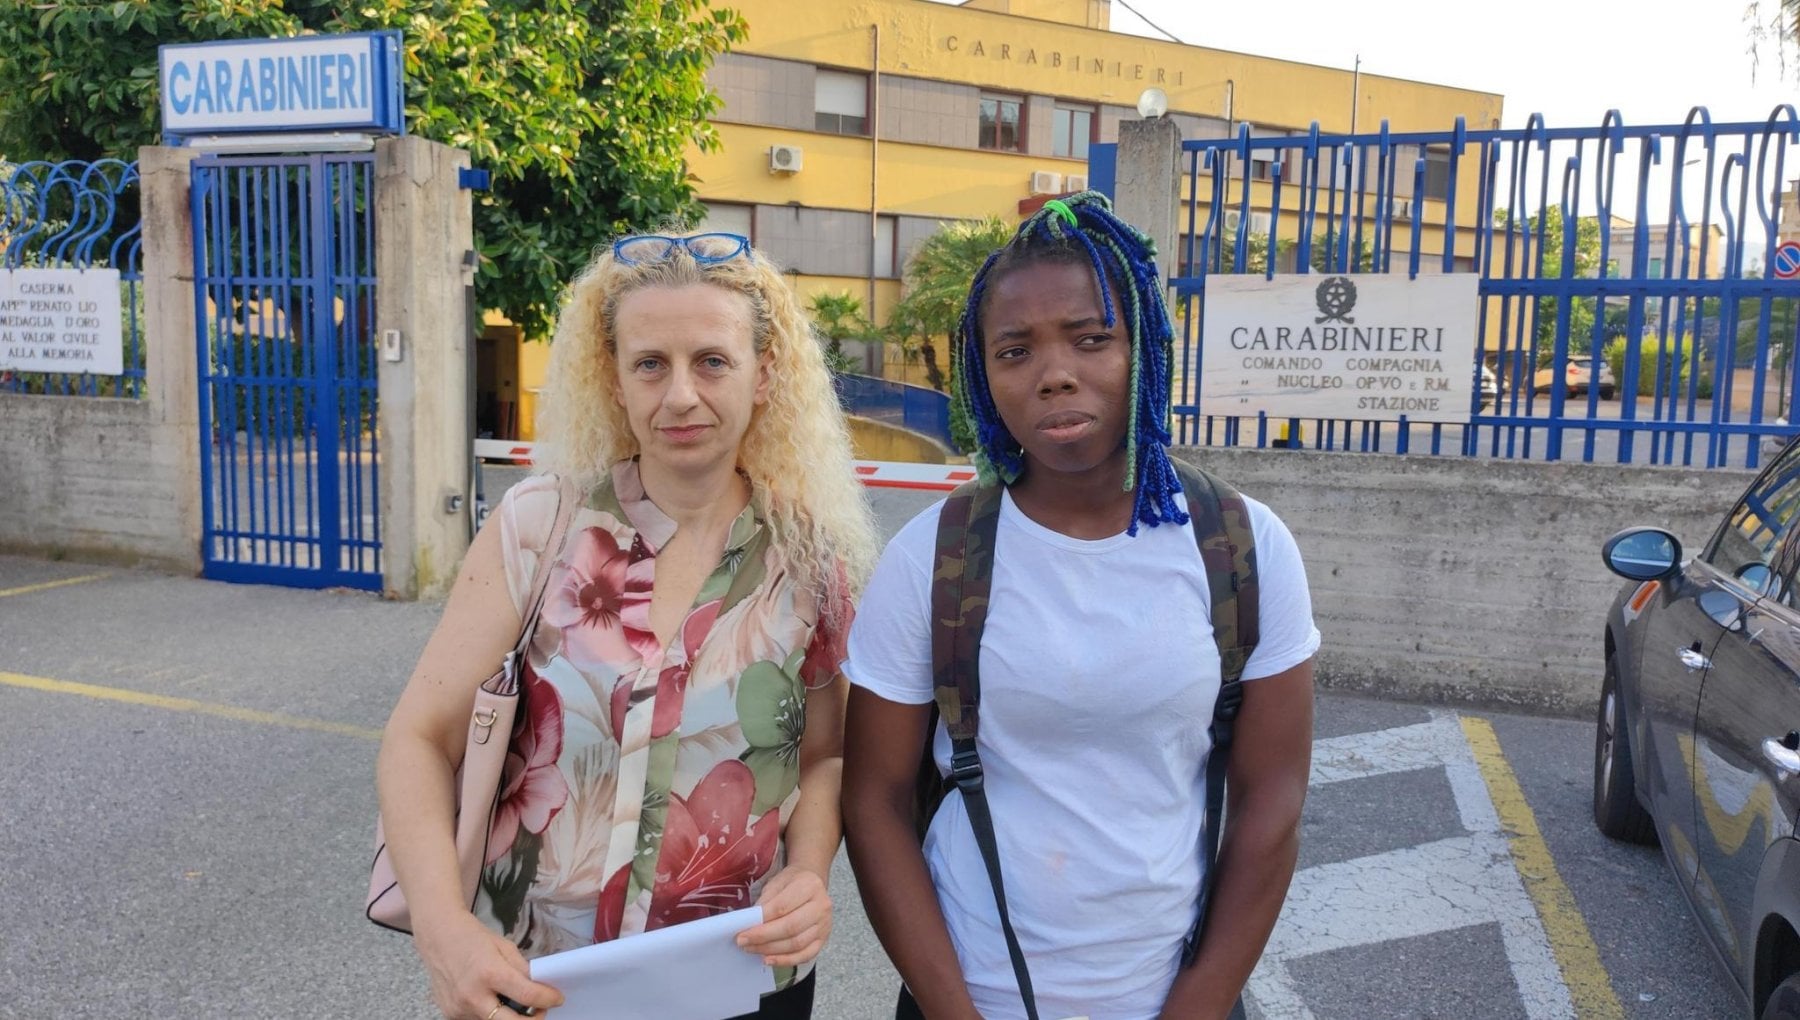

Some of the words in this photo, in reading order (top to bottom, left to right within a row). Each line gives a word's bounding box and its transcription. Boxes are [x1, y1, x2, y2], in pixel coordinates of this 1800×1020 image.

[946, 34, 1184, 86] CARABINIERI
[169, 52, 369, 115] CARABINIERI
[20, 283, 74, 295] CASERMA
[30, 300, 72, 312] RENATO
[79, 301, 97, 313] LIO
[0, 316, 54, 328] MEDAGLIA
[2, 332, 16, 342] AL
[22, 332, 56, 343] VALOR
[62, 333, 99, 345] CIVILE
[1230, 326, 1444, 352] CARABINIERI
[8, 347, 36, 359] ALLA
[42, 348, 94, 360] MEMORIA
[1242, 356, 1323, 370] COMANDO
[1345, 358, 1443, 373] COMPAGNIA
[1277, 374, 1343, 389] NUCLEO
[1357, 396, 1440, 412] STAZIONE
